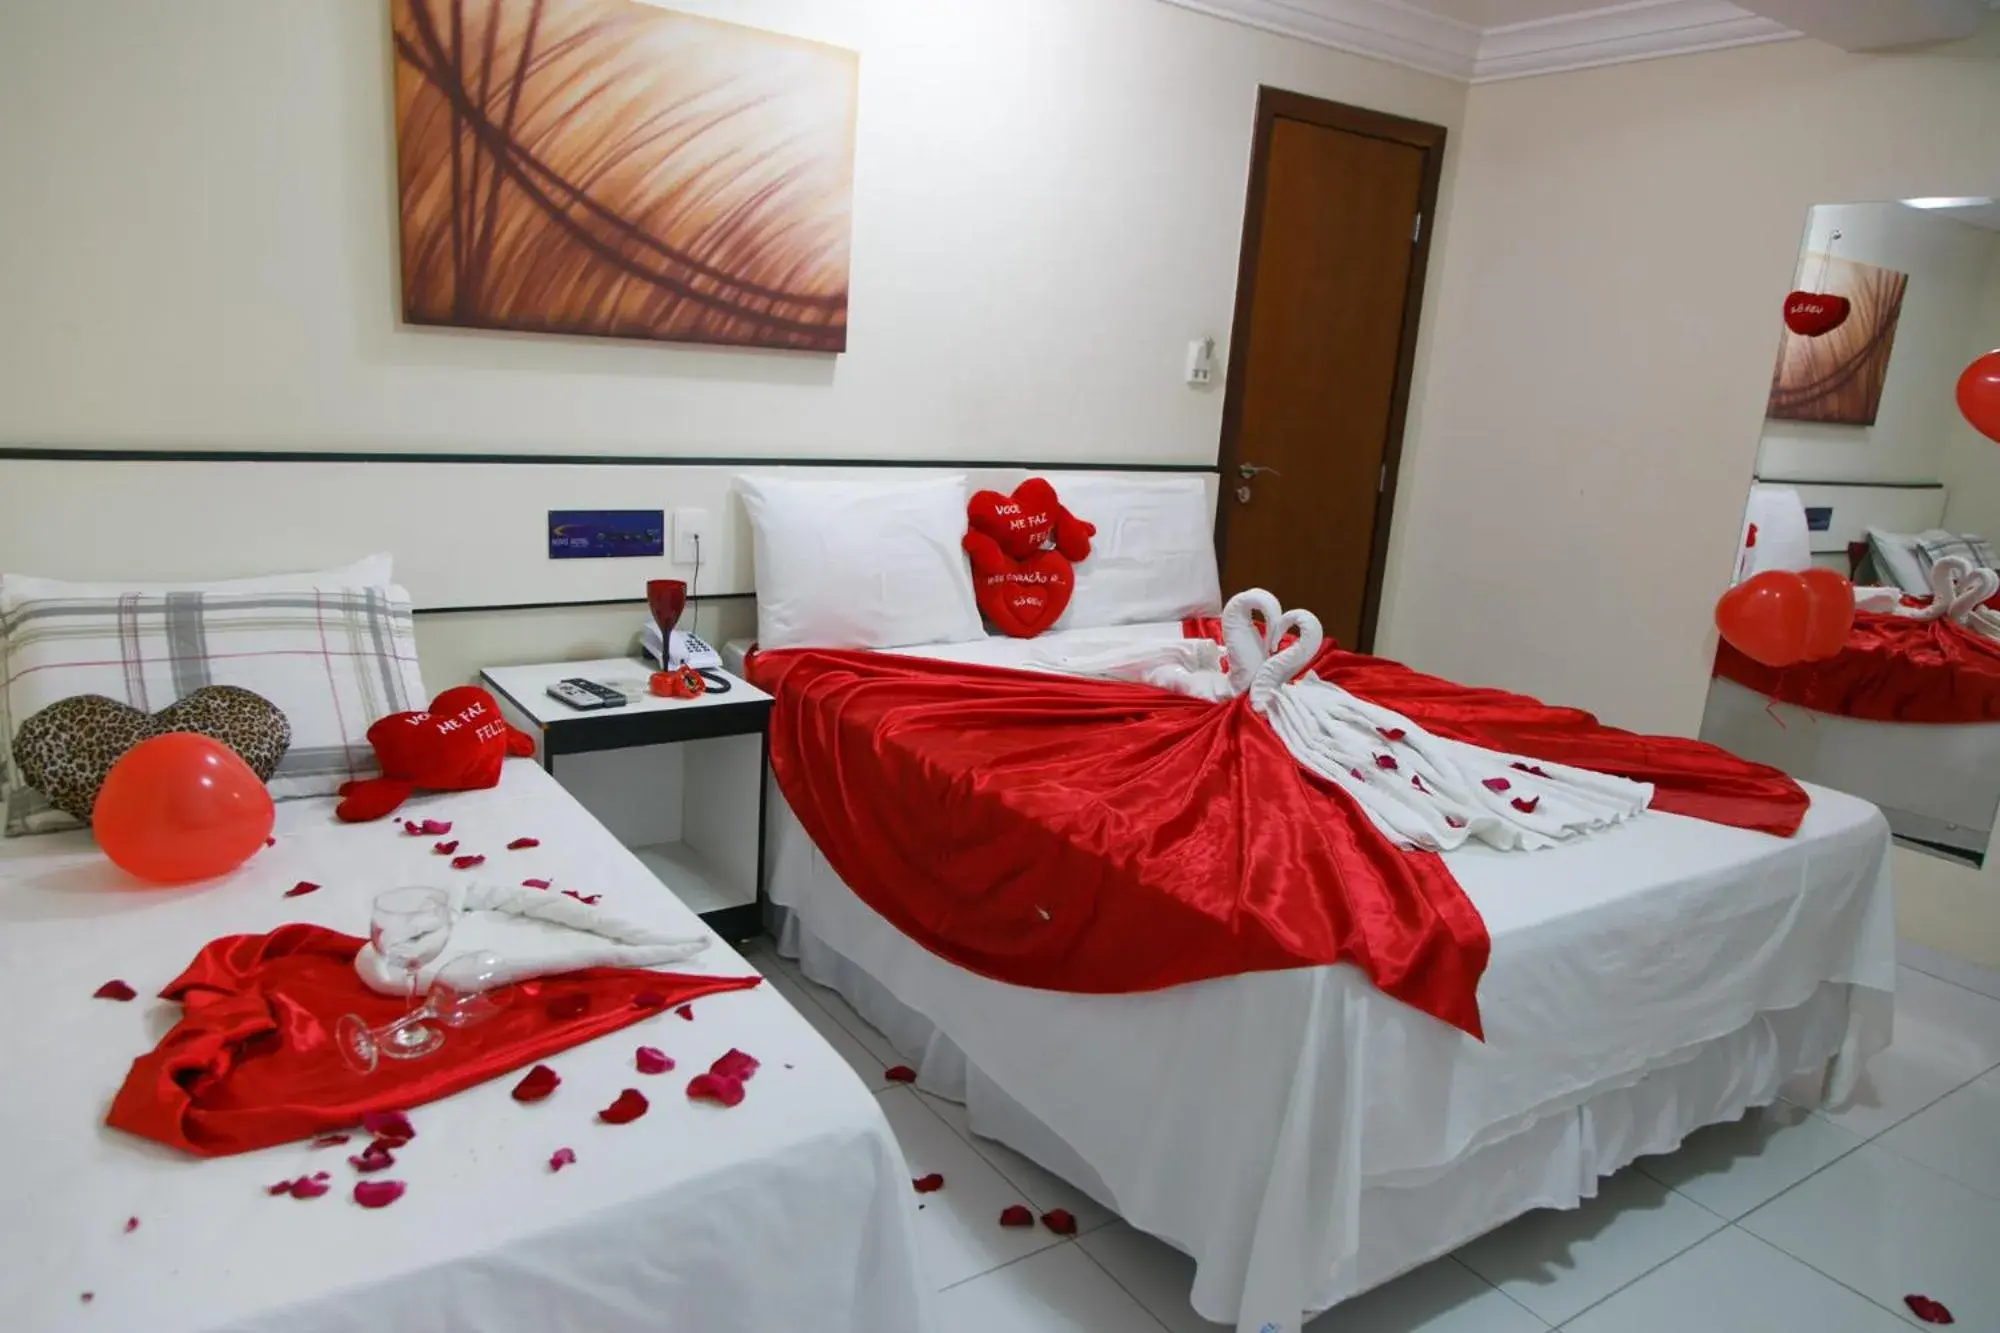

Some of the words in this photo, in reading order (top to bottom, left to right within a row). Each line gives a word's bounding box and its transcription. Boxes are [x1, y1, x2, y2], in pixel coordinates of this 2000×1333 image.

[1009, 518, 1026, 530] ME
[1027, 512, 1048, 528] FAZ
[436, 718, 462, 735] ME
[458, 701, 487, 723] FAZ
